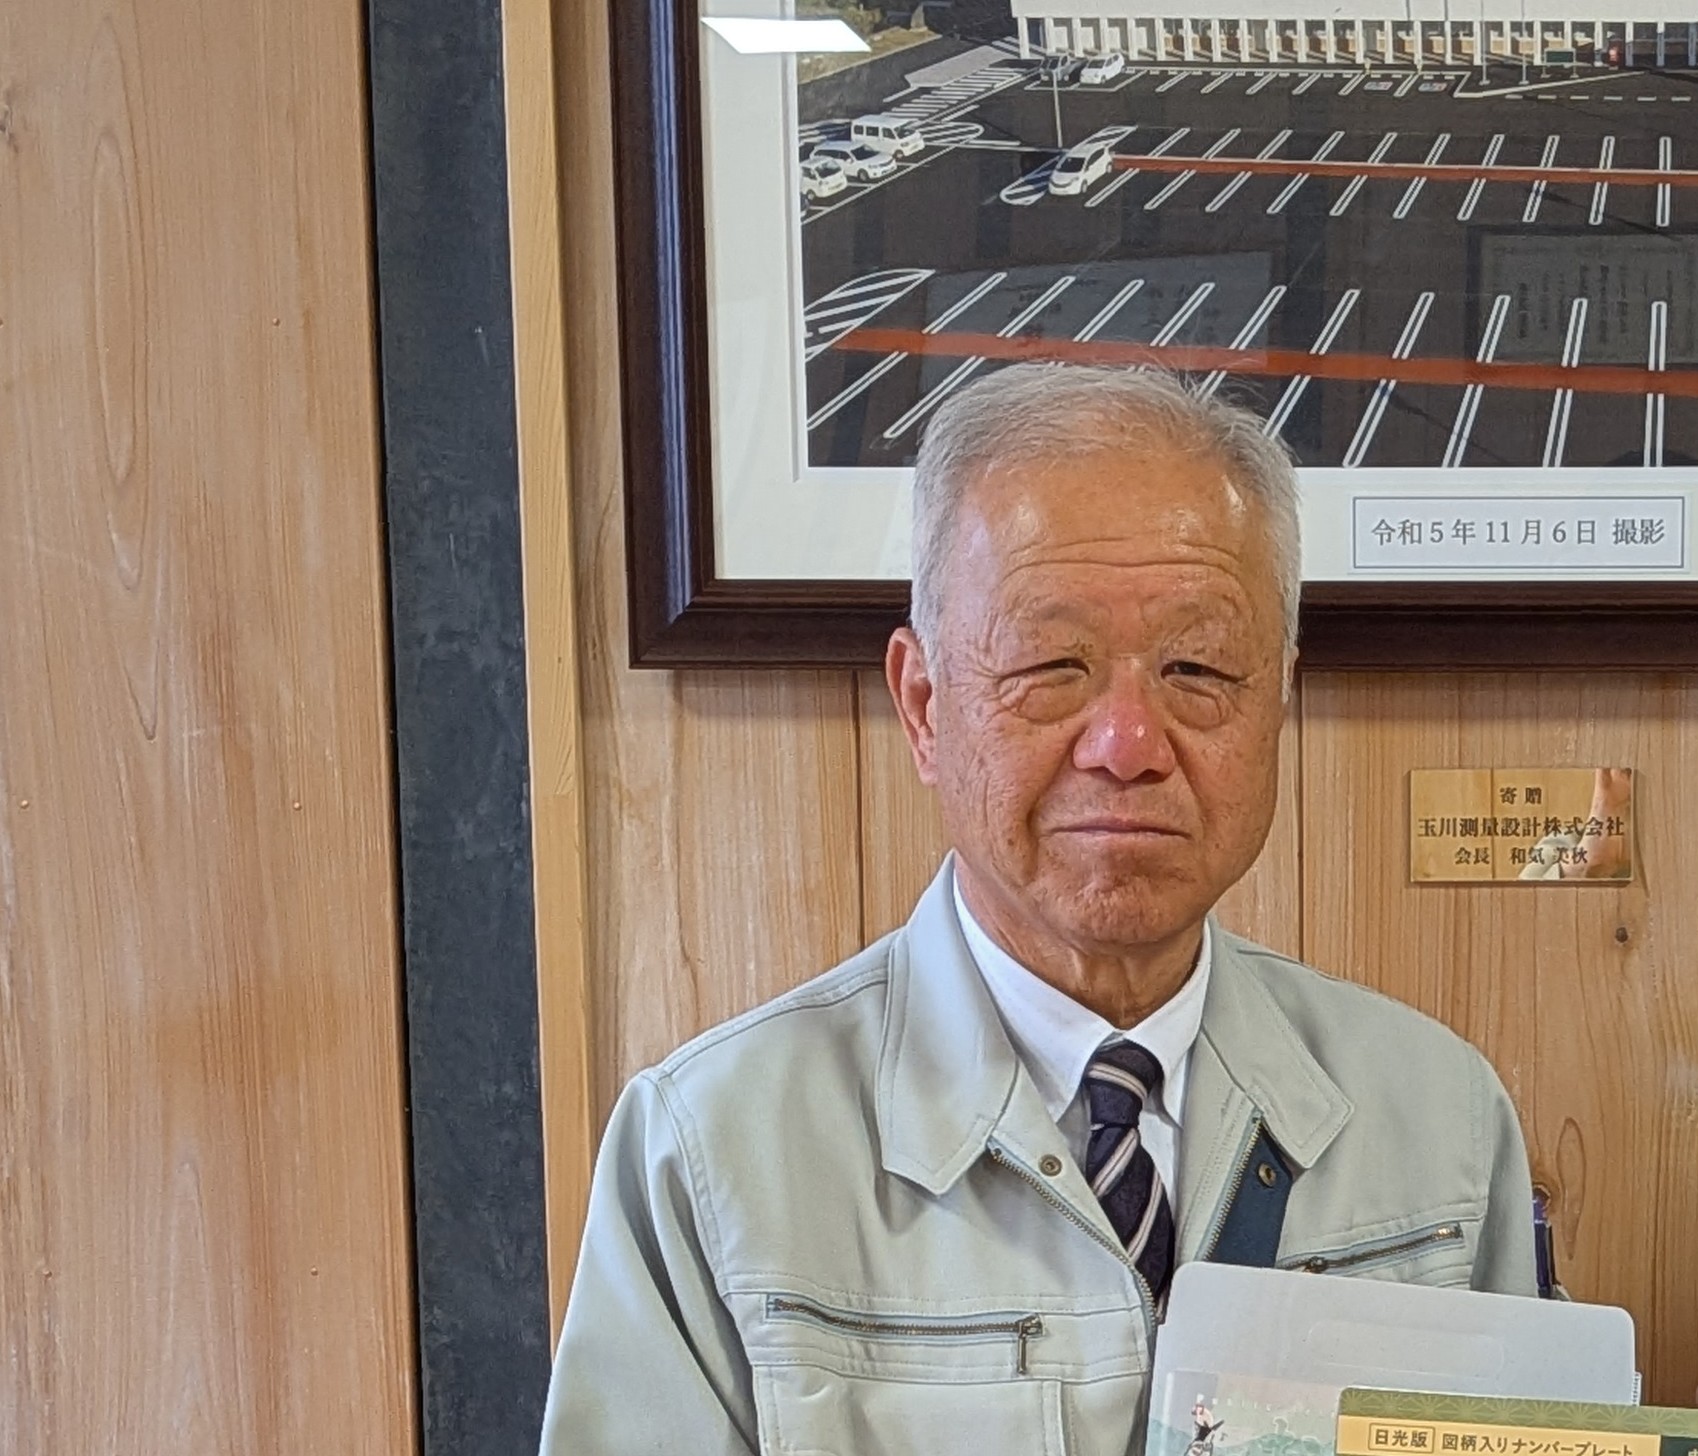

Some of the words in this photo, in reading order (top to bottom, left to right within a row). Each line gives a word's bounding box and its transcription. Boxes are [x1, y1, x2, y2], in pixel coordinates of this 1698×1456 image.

[1371, 518, 1597, 546] 令和5年11月6日
[1612, 518, 1666, 546] 撮影
[1417, 816, 1625, 838] 玉川測量設計株式会社
[1455, 846, 1490, 865] 会長
[1374, 1428, 1429, 1449] 日光版
